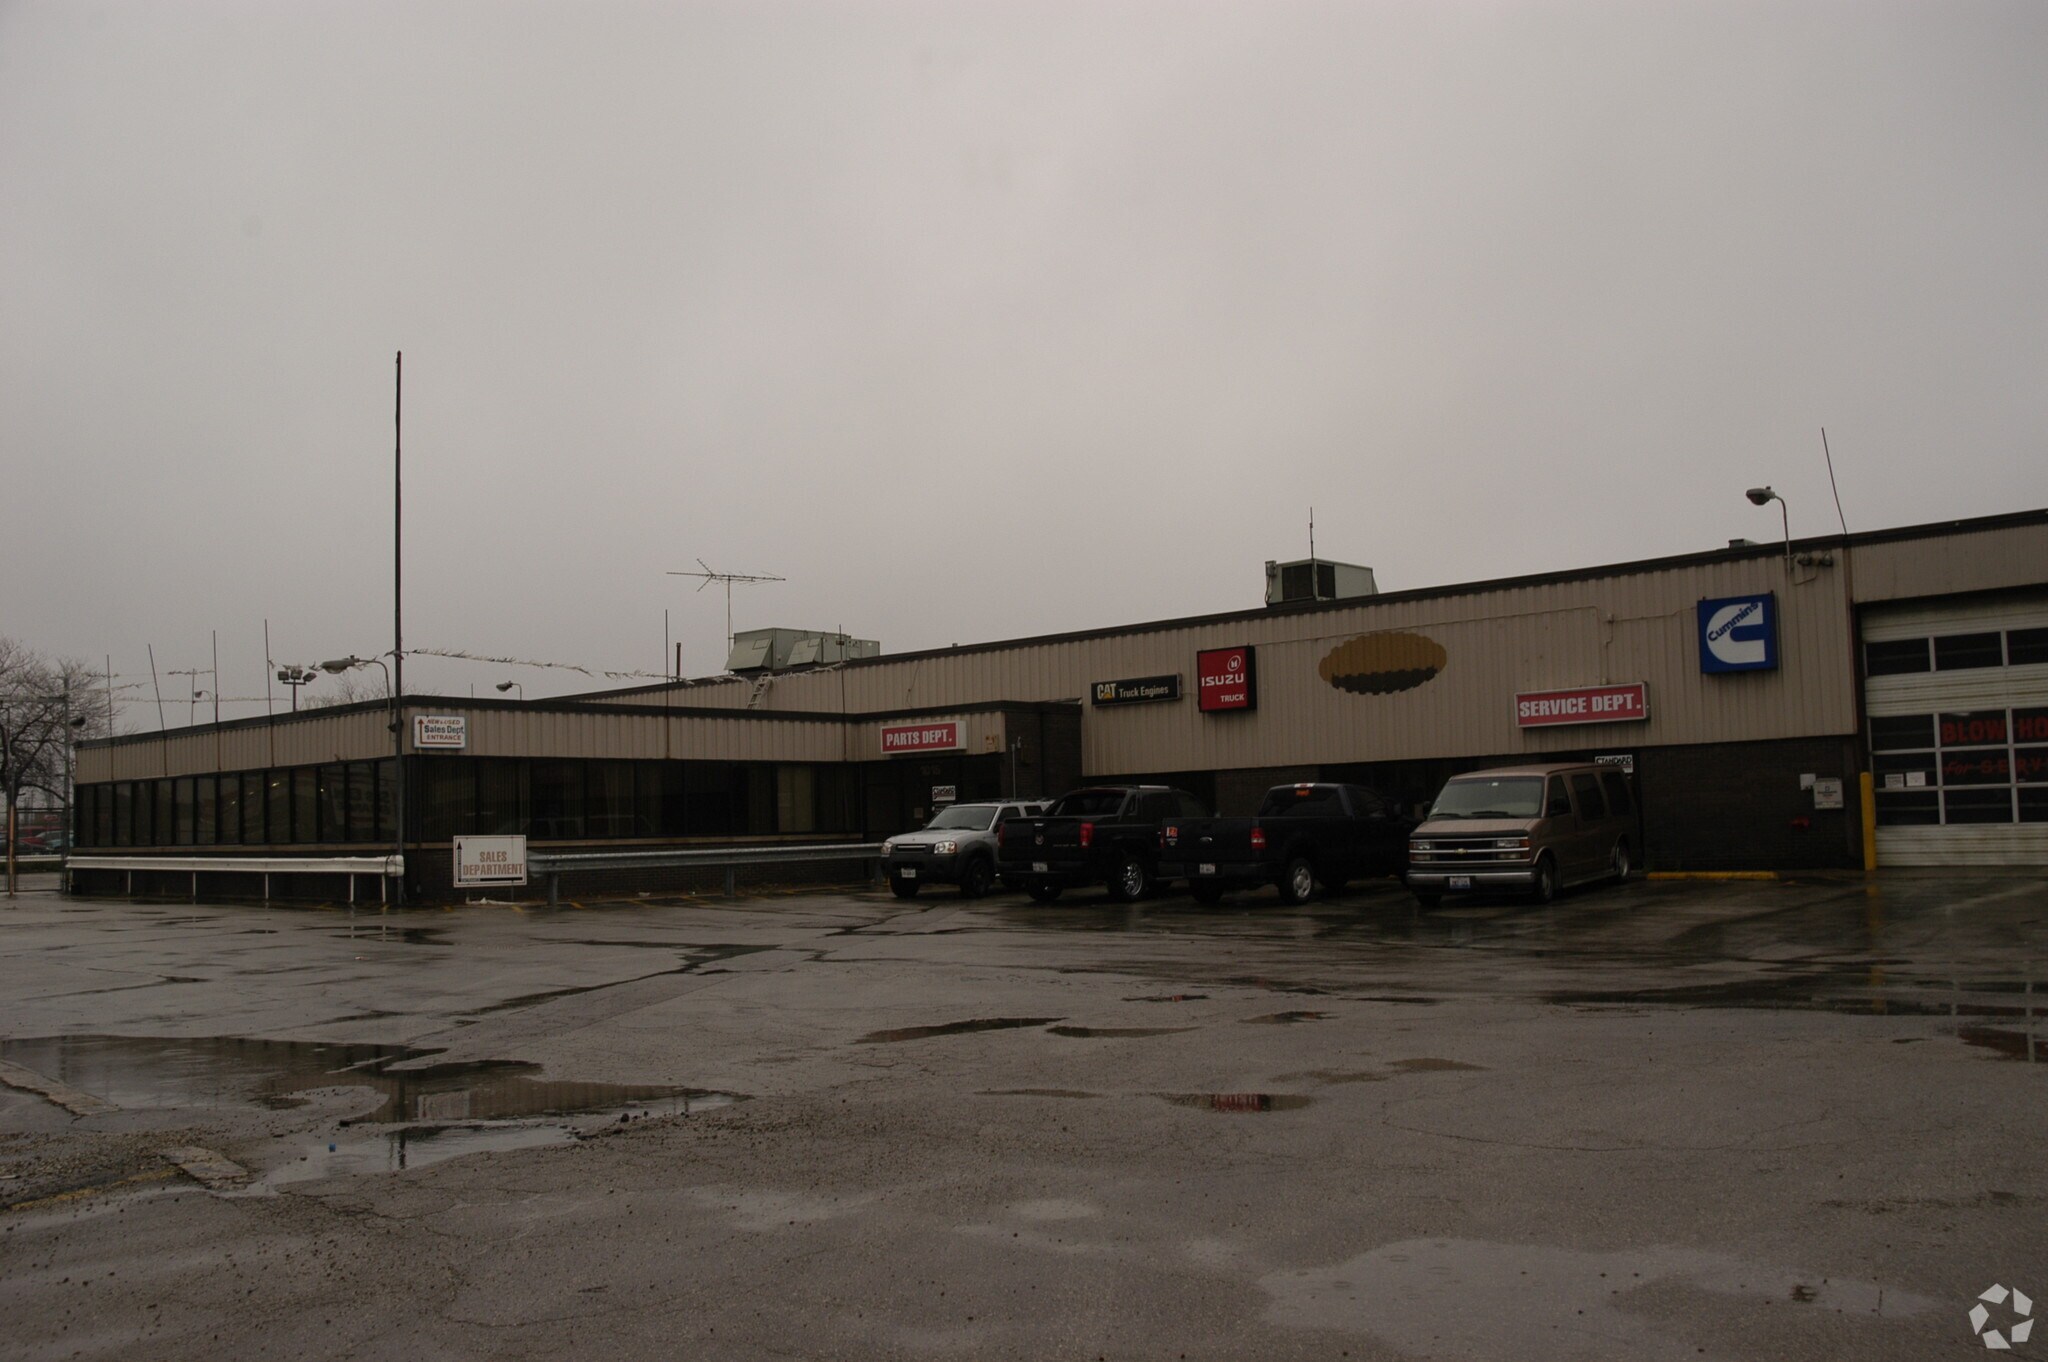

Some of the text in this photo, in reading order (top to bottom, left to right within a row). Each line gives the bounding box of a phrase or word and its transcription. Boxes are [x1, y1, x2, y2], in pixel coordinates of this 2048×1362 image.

[1708, 602, 1759, 641] Cummins
[1201, 672, 1244, 687] ISUZU
[1097, 683, 1169, 700] CAT Truck Engines
[1220, 693, 1245, 703] TRUCK
[1519, 693, 1642, 718] SERVICE DEPT.
[424, 725, 446, 734] Sales
[1941, 719, 2006, 744] BLOW
[886, 729, 952, 747] PARTS DEPT.
[480, 851, 507, 862] SALES
[463, 864, 524, 875] DEPARTMENT
